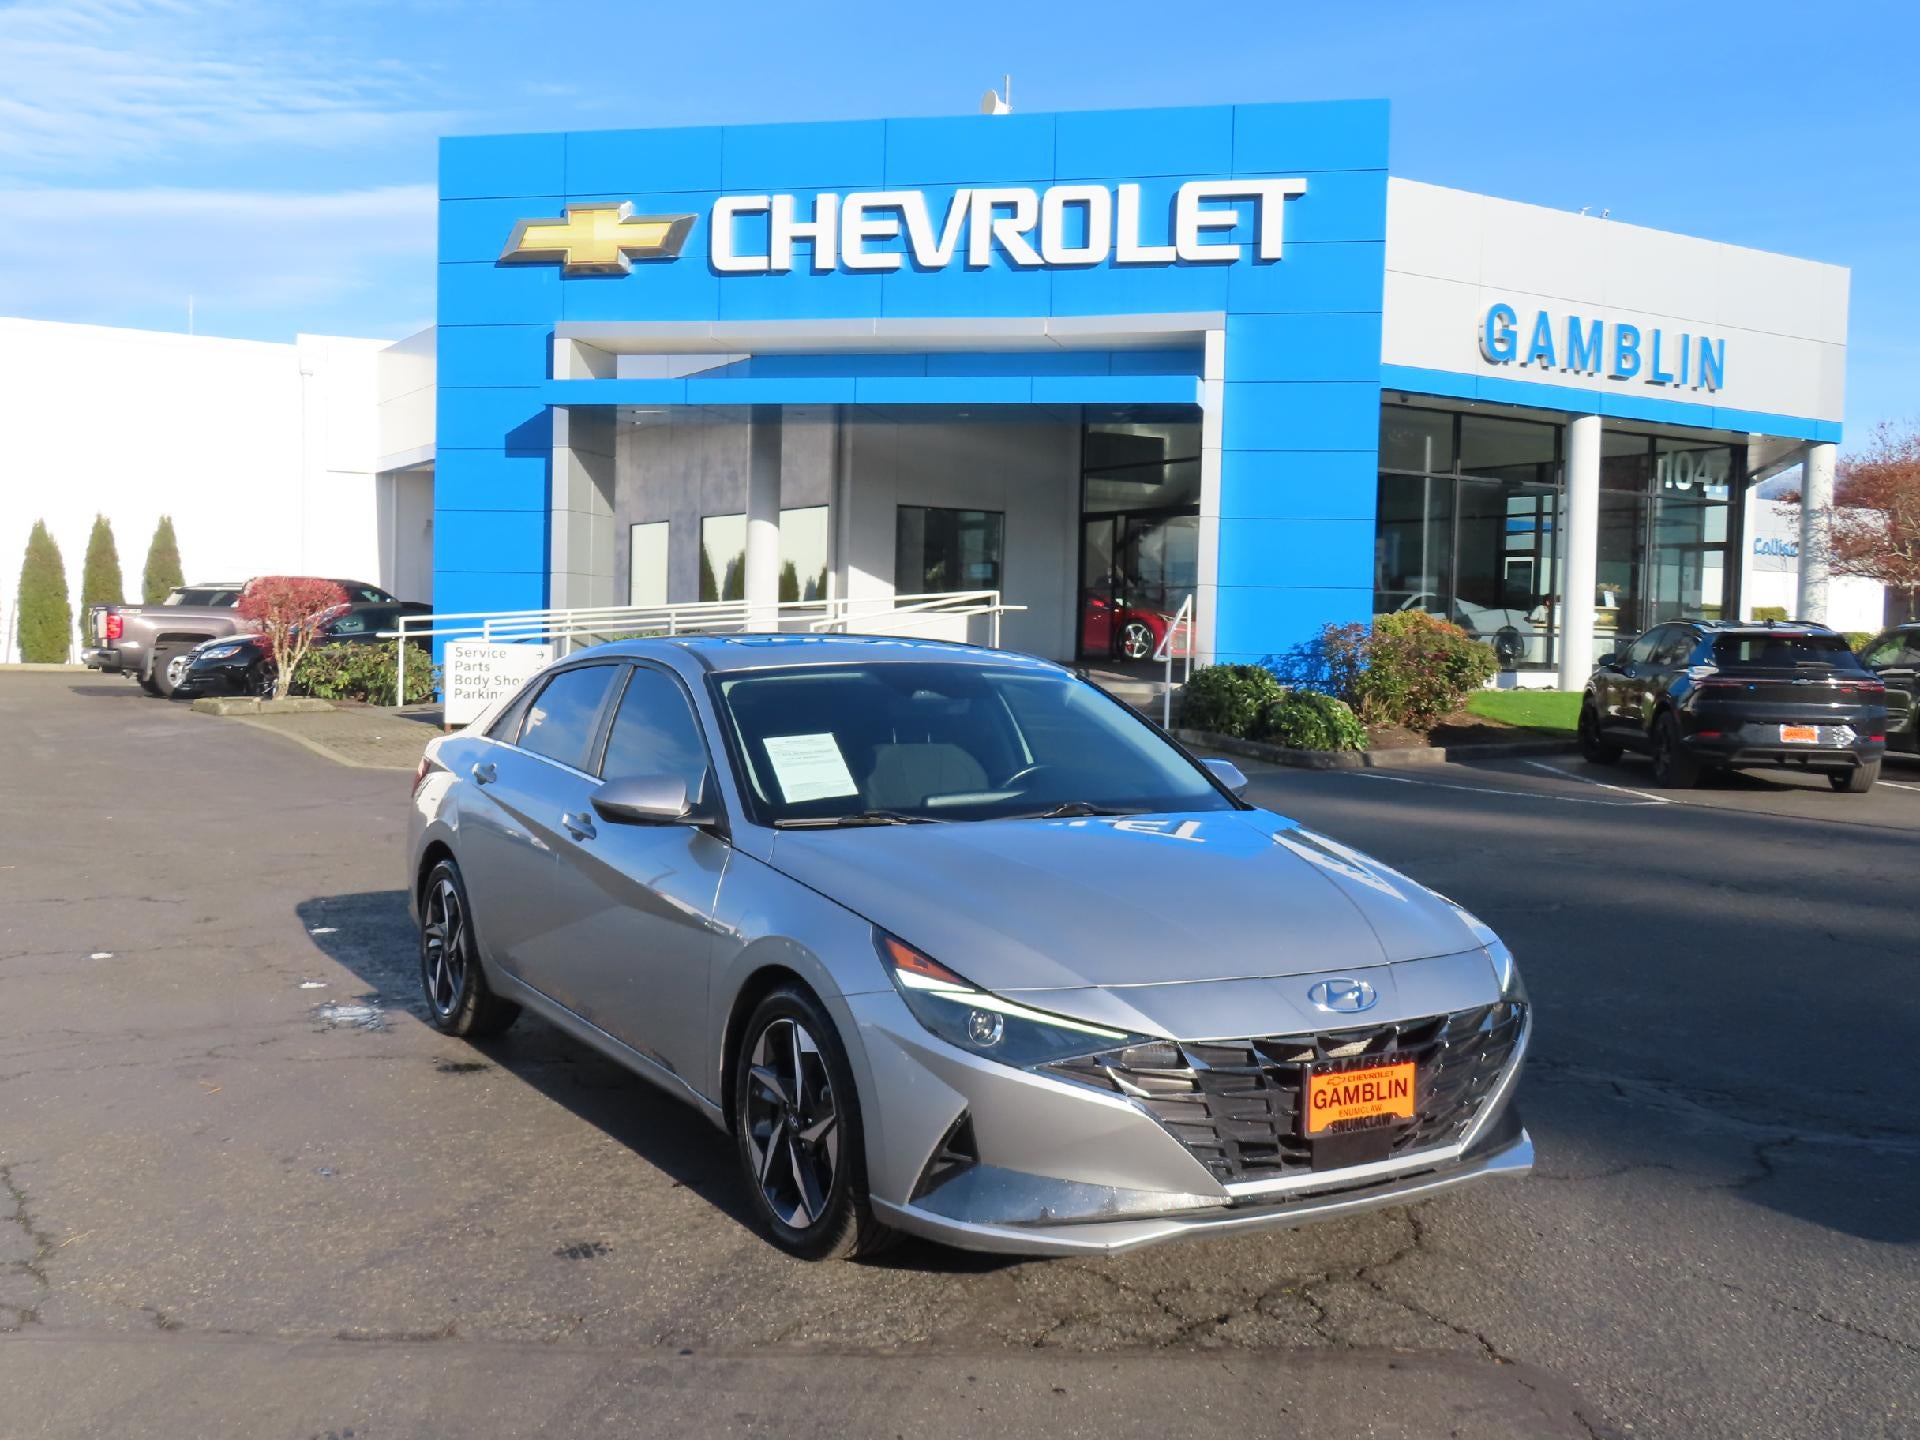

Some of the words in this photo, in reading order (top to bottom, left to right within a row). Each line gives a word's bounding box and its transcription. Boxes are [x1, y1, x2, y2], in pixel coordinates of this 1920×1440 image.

[711, 178, 1307, 272] CHEVROLET
[1480, 302, 1725, 391] GAMBLIN
[455, 646, 507, 659] Service
[455, 660, 490, 672] Parts
[455, 675, 490, 688] Body
[495, 675, 524, 686] Sho
[455, 688, 504, 699] Parkin
[1347, 1070, 1394, 1082] CHEVROLET
[1313, 1078, 1408, 1110] GAMBLIN
[1338, 1103, 1383, 1118] ENUMCLAW
